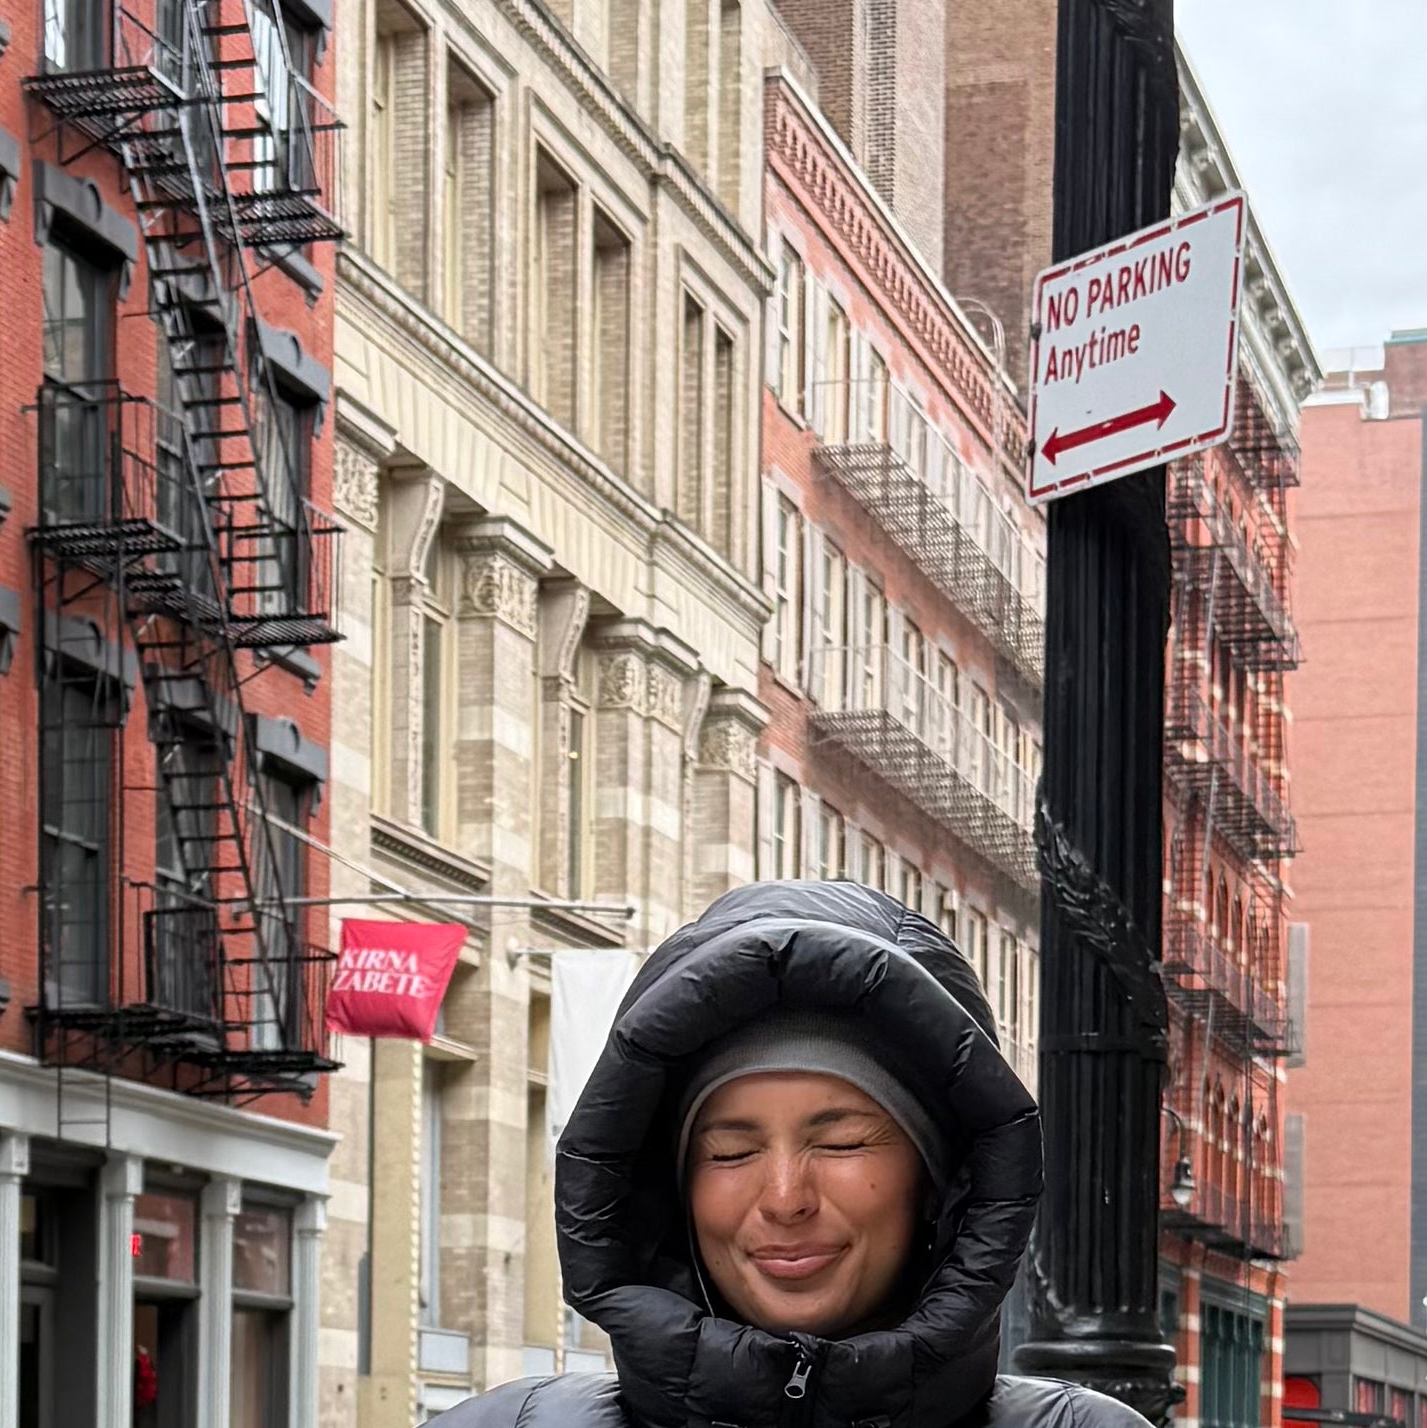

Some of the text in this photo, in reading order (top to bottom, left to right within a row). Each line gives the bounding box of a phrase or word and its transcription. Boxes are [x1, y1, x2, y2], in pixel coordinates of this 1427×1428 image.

[1047, 241, 1191, 334] NO PARKING
[1044, 323, 1140, 385] Anytime
[338, 948, 418, 973] KIRNA
